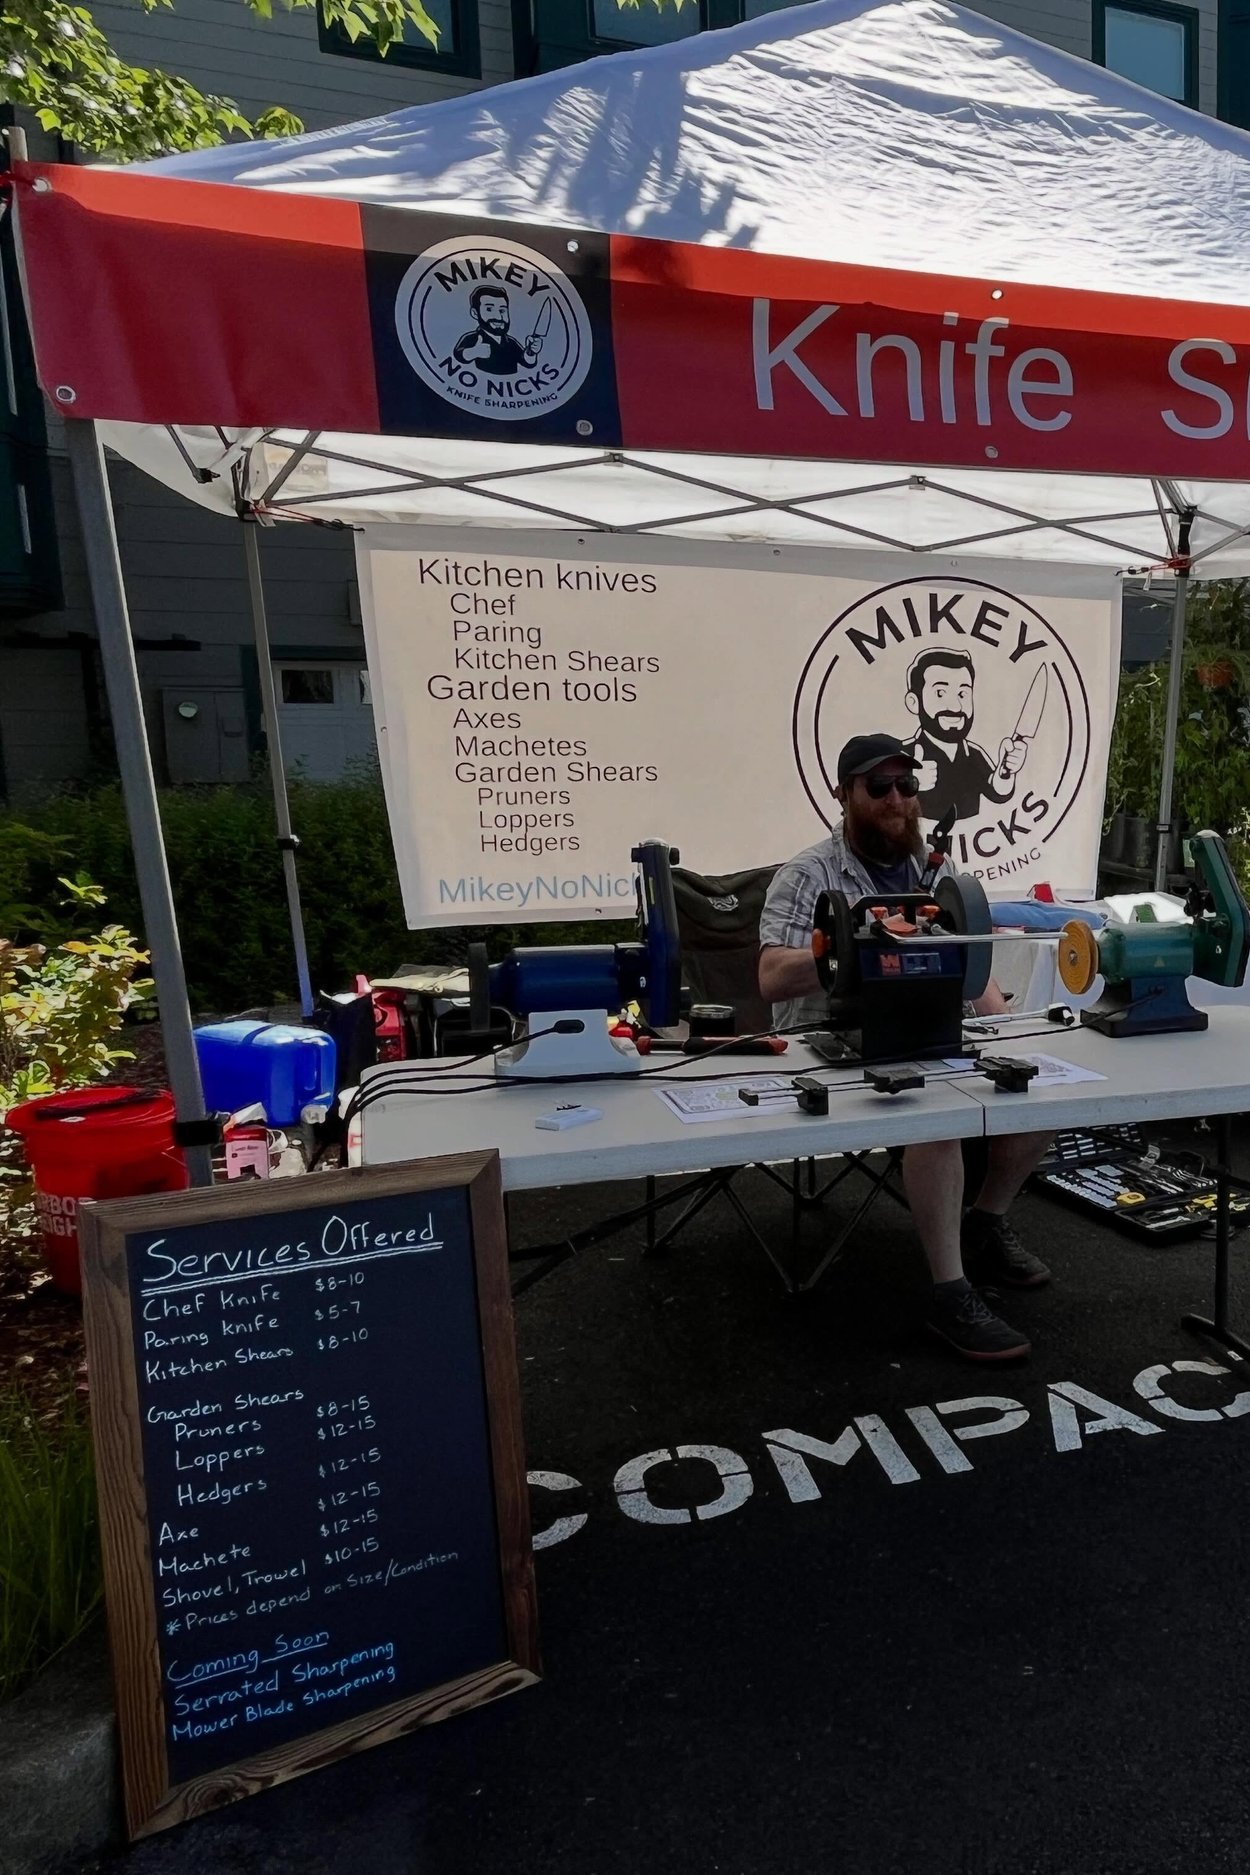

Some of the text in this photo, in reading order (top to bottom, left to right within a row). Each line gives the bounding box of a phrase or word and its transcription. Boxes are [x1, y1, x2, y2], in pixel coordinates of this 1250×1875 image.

[433, 256, 550, 297] MIKEY
[438, 356, 560, 397] NO NICKS
[751, 297, 1075, 433] Knife
[446, 386, 558, 409] KNIFE SHARPENING
[418, 558, 657, 593] Kitchen knives
[450, 592, 516, 616] Chef
[453, 620, 542, 649] Paring
[845, 592, 1048, 665] MIKEY
[454, 648, 660, 673] Kitchen Shears
[426, 674, 638, 702] Garden tools
[453, 708, 522, 729] Axes
[455, 735, 587, 757] Machetes
[454, 762, 658, 782] Garden Shears
[477, 787, 571, 806] Pruners
[479, 810, 575, 834] Loppers
[480, 833, 580, 856] Hedgers
[142, 1213, 435, 1282] Services Offered
[143, 1271, 365, 1321] Chef Knife $8-10
[144, 1331, 209, 1350] Paring
[314, 1301, 361, 1321] $5-7
[145, 1327, 369, 1384] Kitchen Shears $8-10
[147, 1388, 304, 1424] Garden Shears
[174, 1395, 371, 1442] Pruners $8-15
[175, 1415, 377, 1472] Loppers $12-15
[177, 1447, 381, 1507] Hedgers $12-15
[158, 1482, 381, 1546] Axe $12-15
[158, 1509, 379, 1577] Machete $12-15
[162, 1537, 380, 1608] Shovel, Trowel $10-15
[246, 1587, 311, 1617] depend
[324, 1583, 342, 1595] on
[167, 1629, 330, 1682] Coming Soon
[174, 1641, 395, 1716] Serrated Sharpening
[172, 1714, 238, 1742] Mower
[245, 1699, 294, 1724] Blade
